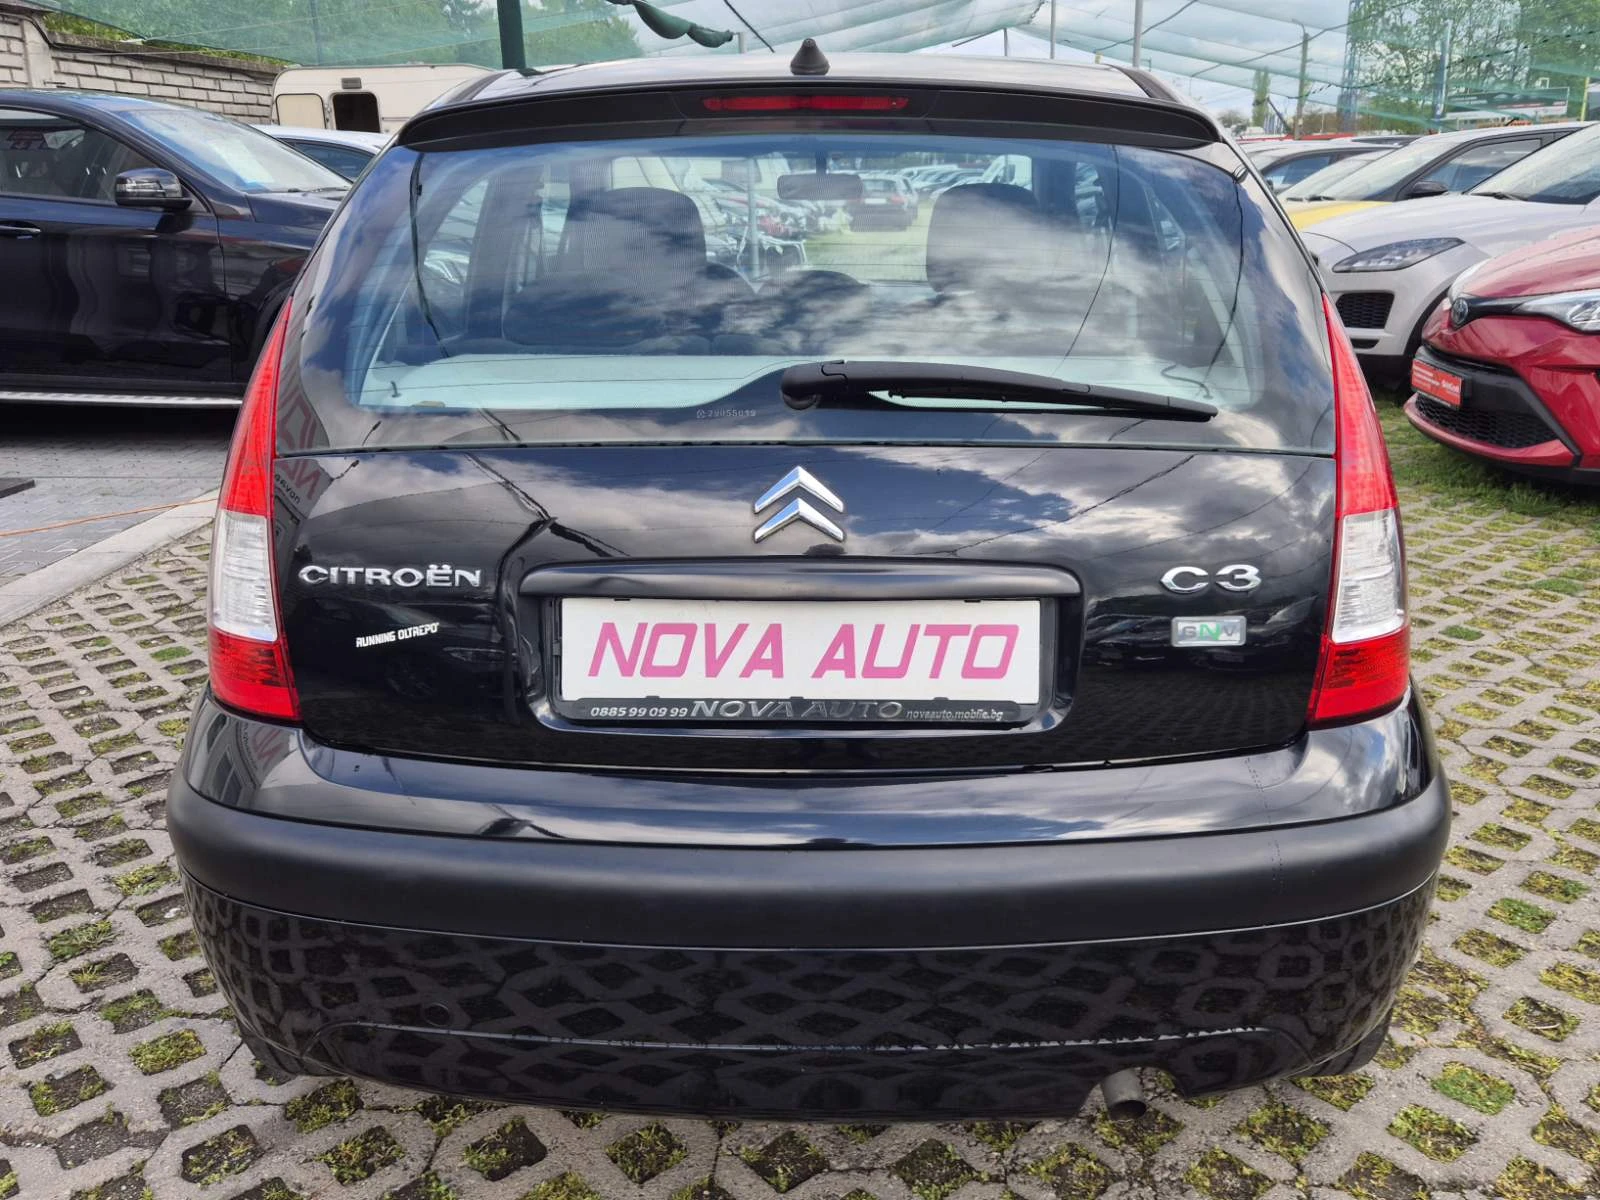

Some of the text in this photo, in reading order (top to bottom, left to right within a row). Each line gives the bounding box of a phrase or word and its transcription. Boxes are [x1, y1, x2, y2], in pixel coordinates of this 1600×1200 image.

[298, 564, 482, 588] CITROËN
[355, 631, 396, 648] RUNNING
[587, 622, 1020, 680] NOVA AUTO
[590, 707, 627, 717] 0885
[628, 707, 647, 717] 99
[649, 707, 667, 717] 09
[669, 707, 688, 717] 99
[690, 700, 793, 718] NOVA
[801, 701, 902, 719] AUTO
